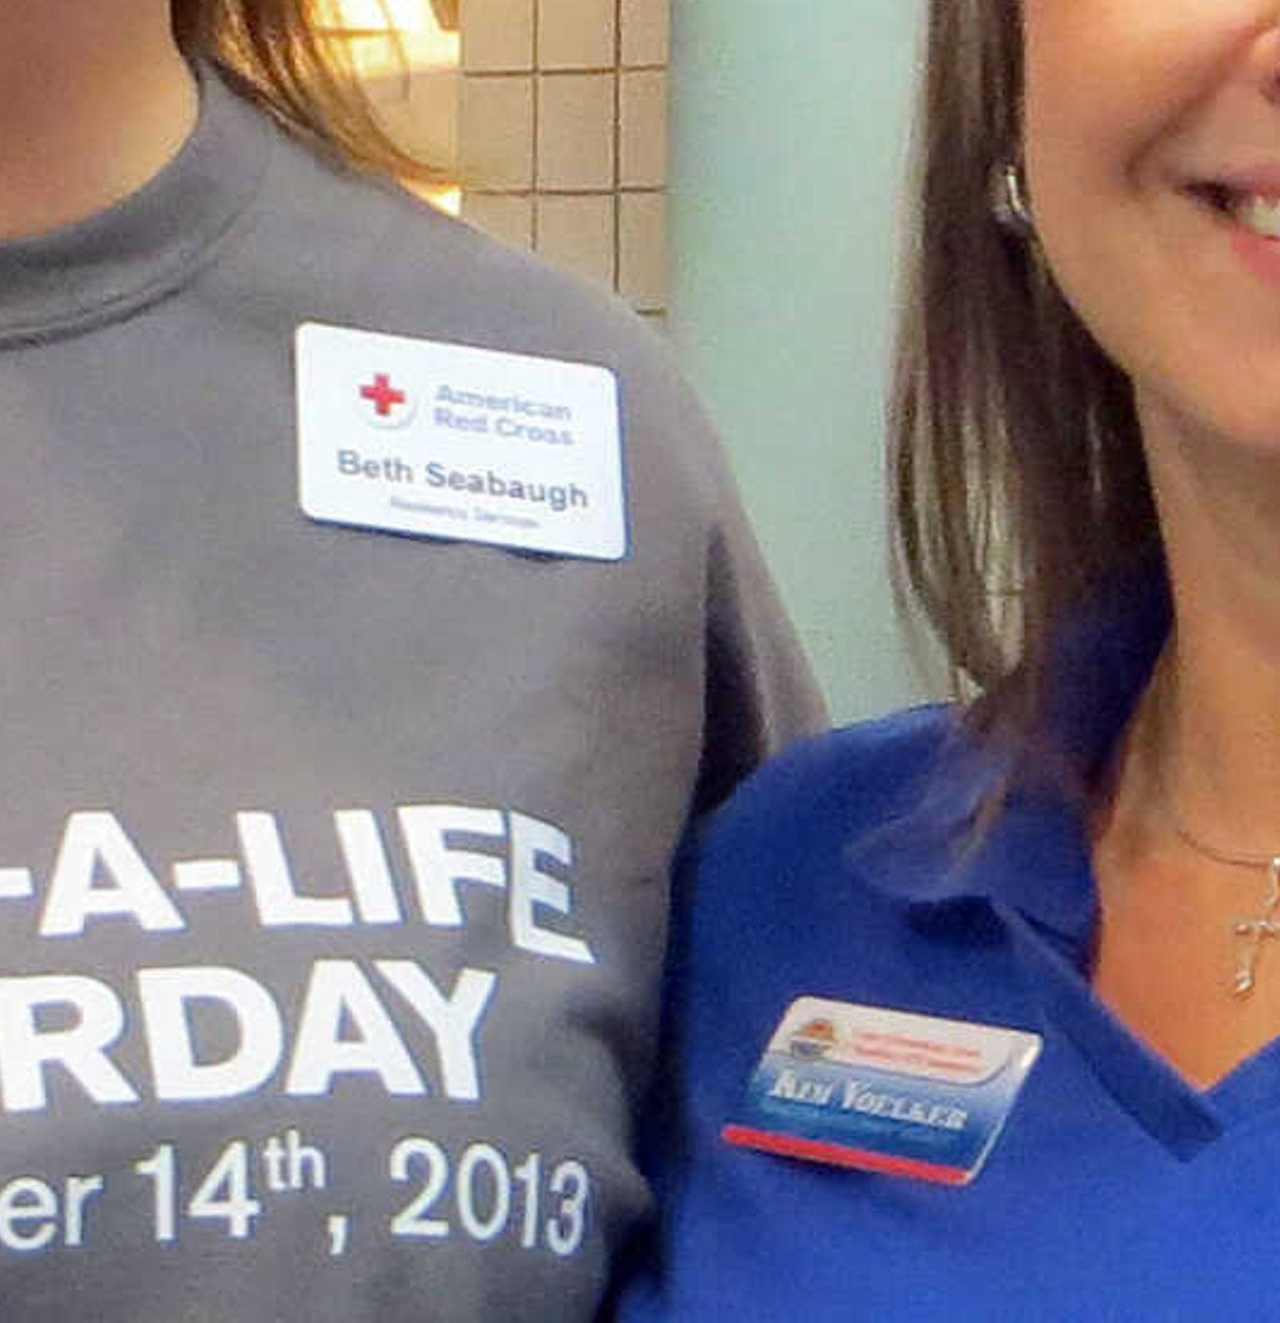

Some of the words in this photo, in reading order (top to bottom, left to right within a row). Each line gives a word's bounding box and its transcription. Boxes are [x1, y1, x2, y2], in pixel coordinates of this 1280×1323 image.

[434, 407, 488, 434] Red
[495, 416, 574, 446] Cross
[436, 384, 572, 421] American
[337, 449, 414, 482] Beth
[425, 461, 589, 511] Seabaugh
[388, 1136, 594, 1258] 2013
